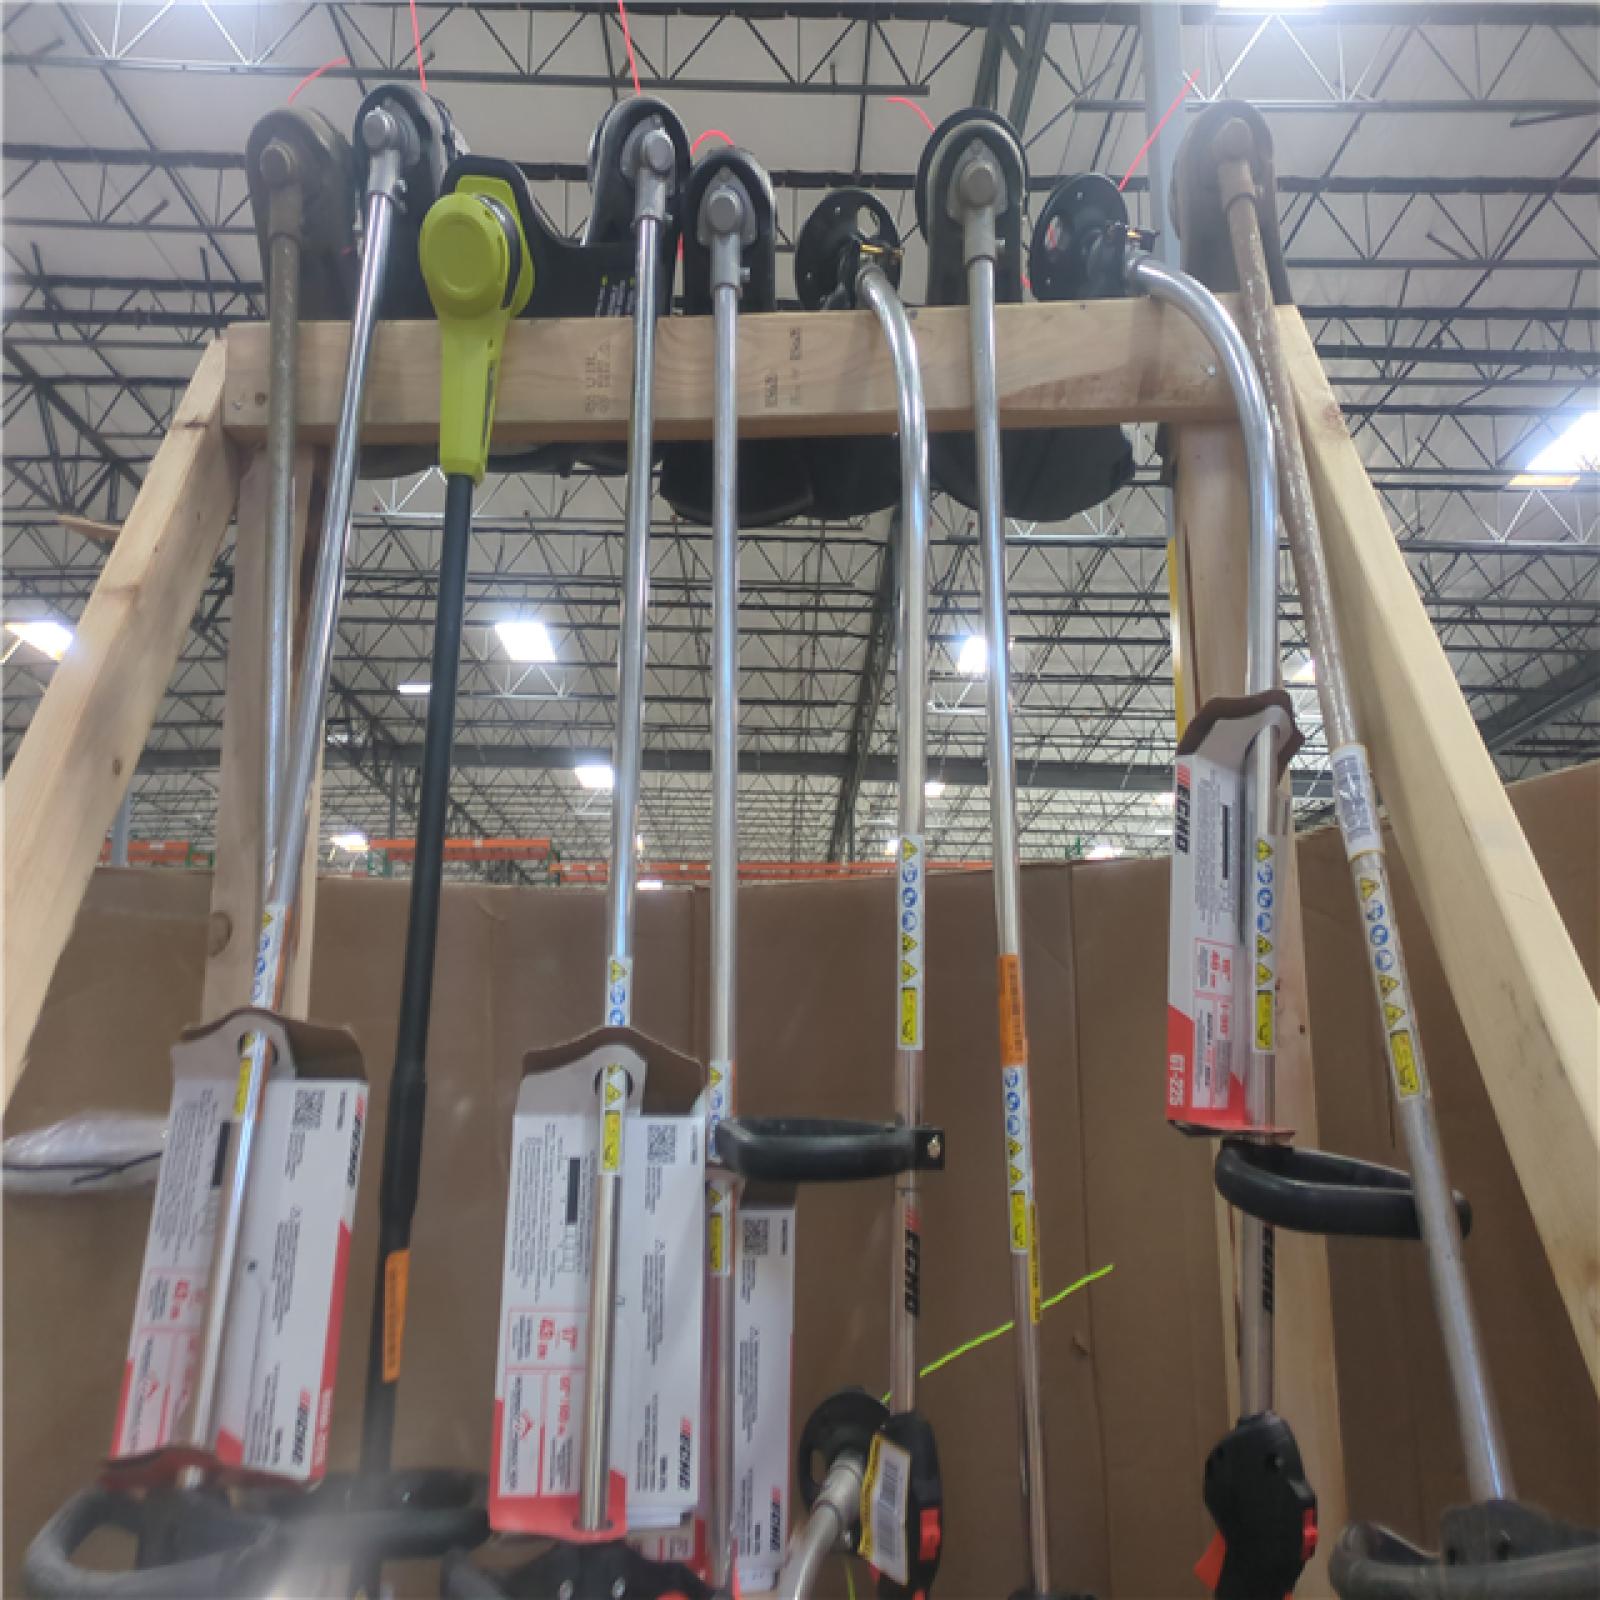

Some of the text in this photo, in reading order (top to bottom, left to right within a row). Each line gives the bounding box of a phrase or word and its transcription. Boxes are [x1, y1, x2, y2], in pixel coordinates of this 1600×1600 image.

[1177, 784, 1191, 854] ECHO
[1169, 1053, 1185, 1106] GT-225
[905, 1228, 921, 1319] ECHO
